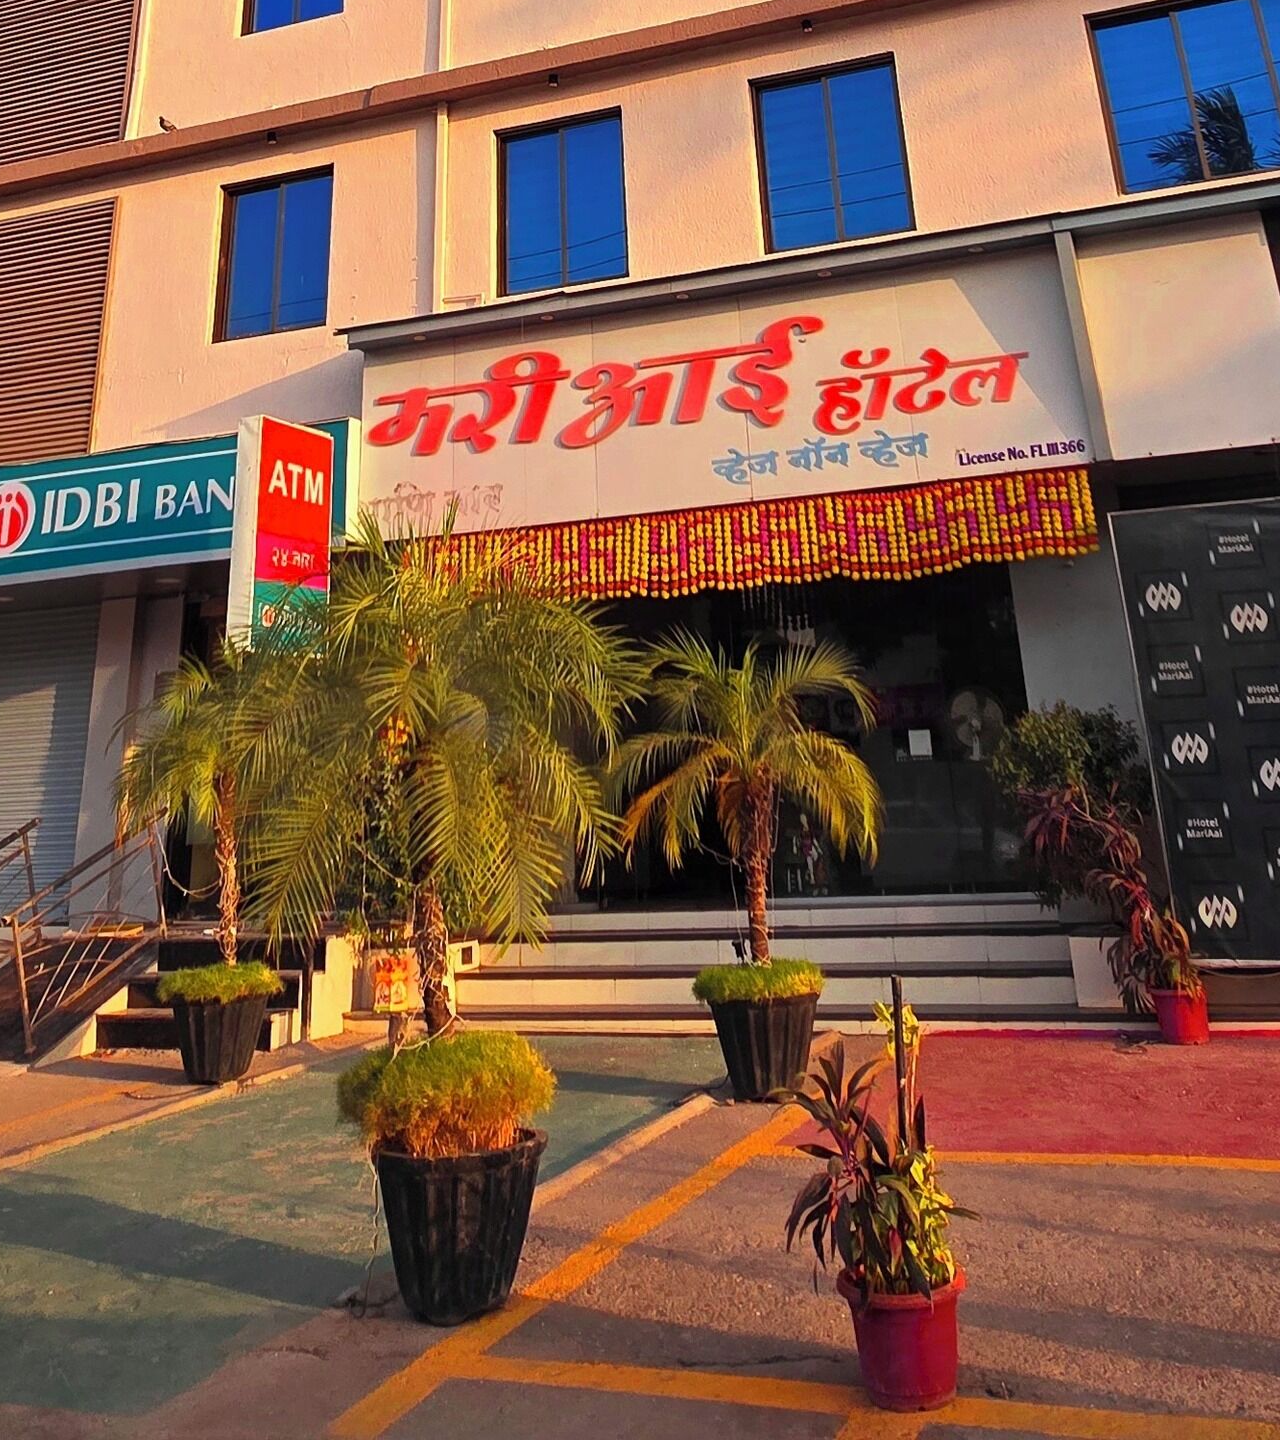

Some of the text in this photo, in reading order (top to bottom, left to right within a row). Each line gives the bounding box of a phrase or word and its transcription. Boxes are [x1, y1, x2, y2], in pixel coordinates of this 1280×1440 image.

[816, 347, 1029, 436] हॉटेल
[711, 429, 929, 485] व्हेज नॉन व्हेज
[958, 451, 1006, 466] License
[1007, 446, 1028, 461] No.
[268, 459, 324, 506] ATM
[41, 476, 235, 535] IDBI BAN
[1218, 533, 1250, 545] #Hotel
[1158, 661, 1189, 672] #Hotel
[1247, 684, 1280, 694] #Hotel
[1187, 818, 1219, 828] #Hotel
